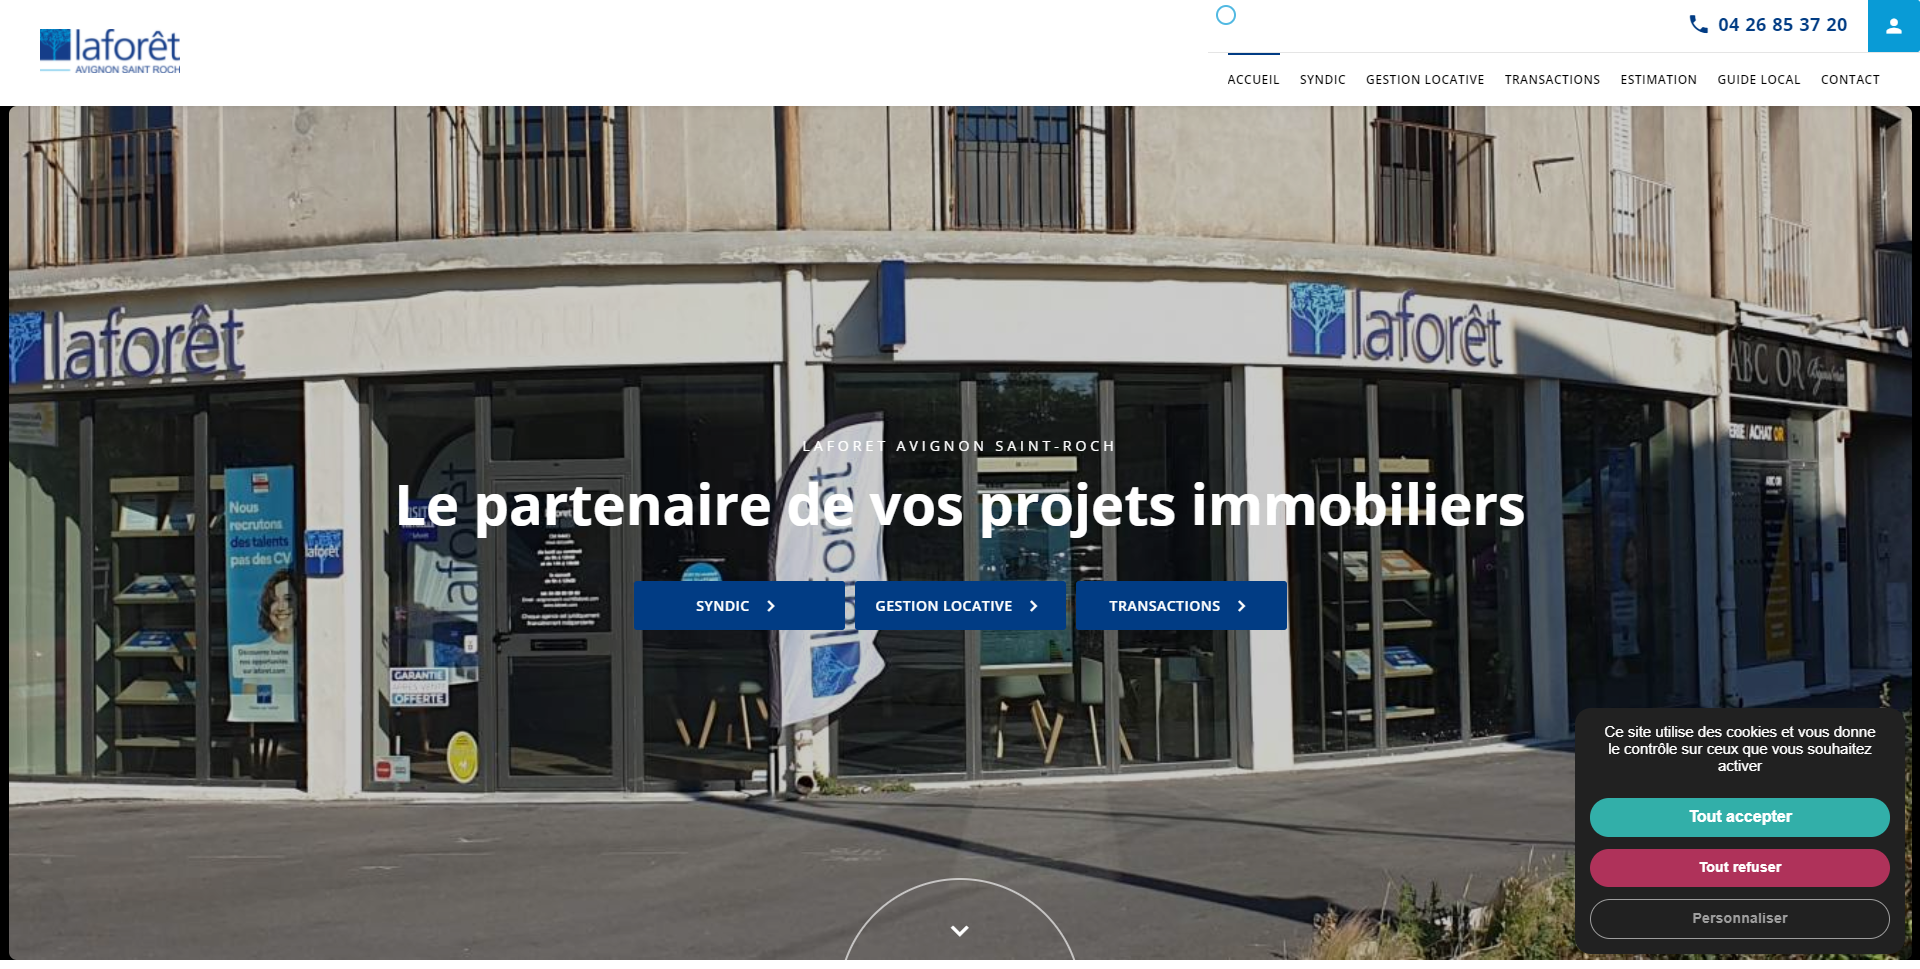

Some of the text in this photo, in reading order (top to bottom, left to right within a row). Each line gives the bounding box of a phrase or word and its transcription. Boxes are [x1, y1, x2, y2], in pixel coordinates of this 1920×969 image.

[1354, 288, 1503, 366] laforêt
[54, 304, 245, 380] laforêt
[1729, 339, 1768, 385] ABC
[1775, 346, 1805, 390] OR
[1749, 424, 1773, 441] ACHAT
[1773, 426, 1784, 441] OR
[229, 502, 259, 513] Nous
[229, 519, 283, 531] recrutons
[230, 536, 289, 548] des talents
[305, 544, 339, 558] laforêt
[230, 552, 292, 568] pas des CV
[394, 671, 444, 680] GARANTIE
[394, 694, 443, 704] OFFERTE
